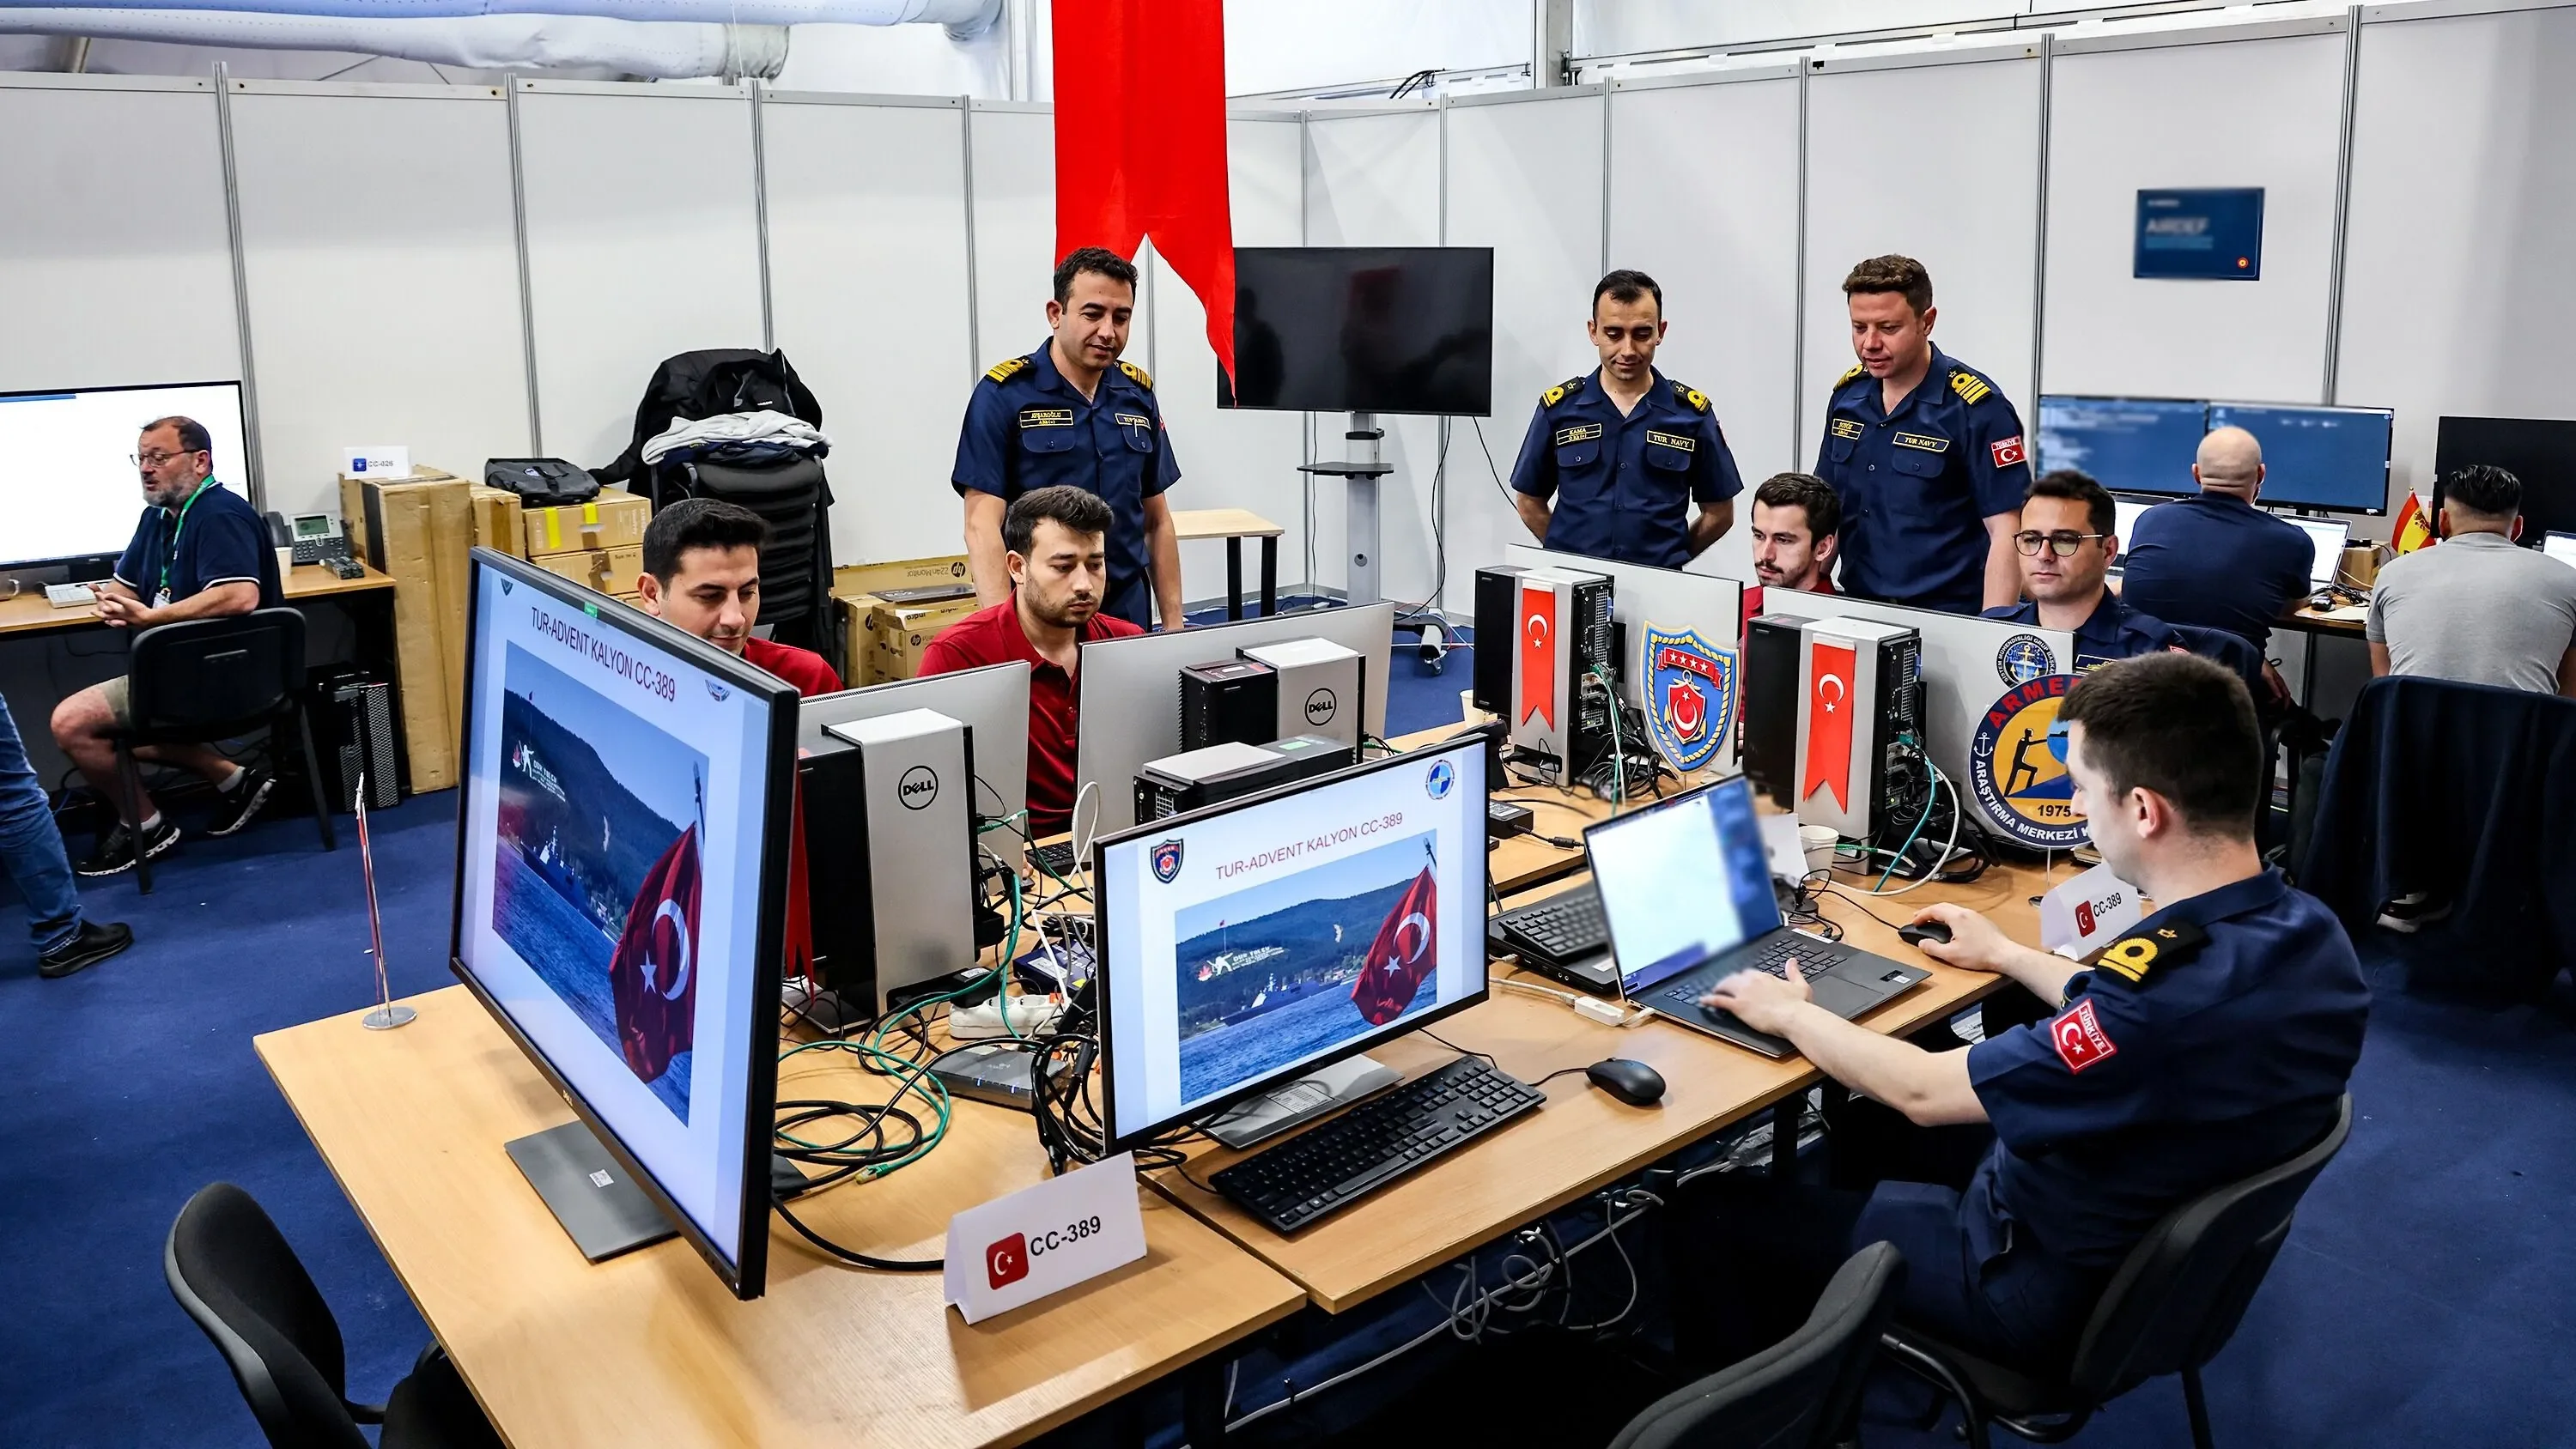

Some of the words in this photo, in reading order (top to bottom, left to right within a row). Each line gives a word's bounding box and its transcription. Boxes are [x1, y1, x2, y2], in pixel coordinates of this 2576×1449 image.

[1671, 439, 1690, 448] NAVY
[1918, 440, 1937, 448] NAVY
[907, 569, 932, 578] Monitor
[951, 561, 966, 578] hp
[532, 606, 590, 656] TUR-ADVENT
[591, 638, 633, 680] KALYON
[635, 662, 676, 702] CC-389
[1309, 700, 1334, 713] DELL
[903, 779, 934, 796] DELL
[1976, 760, 2016, 828] ARAŞTIRMA
[2017, 822, 2079, 841] MERKEZİ
[2038, 804, 2072, 817] 1975
[1216, 842, 1304, 880] TUR-ADVENT
[1307, 826, 1358, 852] KALYON
[1361, 812, 1403, 835] CC-389
[2093, 892, 2123, 918] CC-389
[2081, 1009, 2106, 1049] TÜRKİYE
[1030, 1216, 1101, 1256] CC-389
